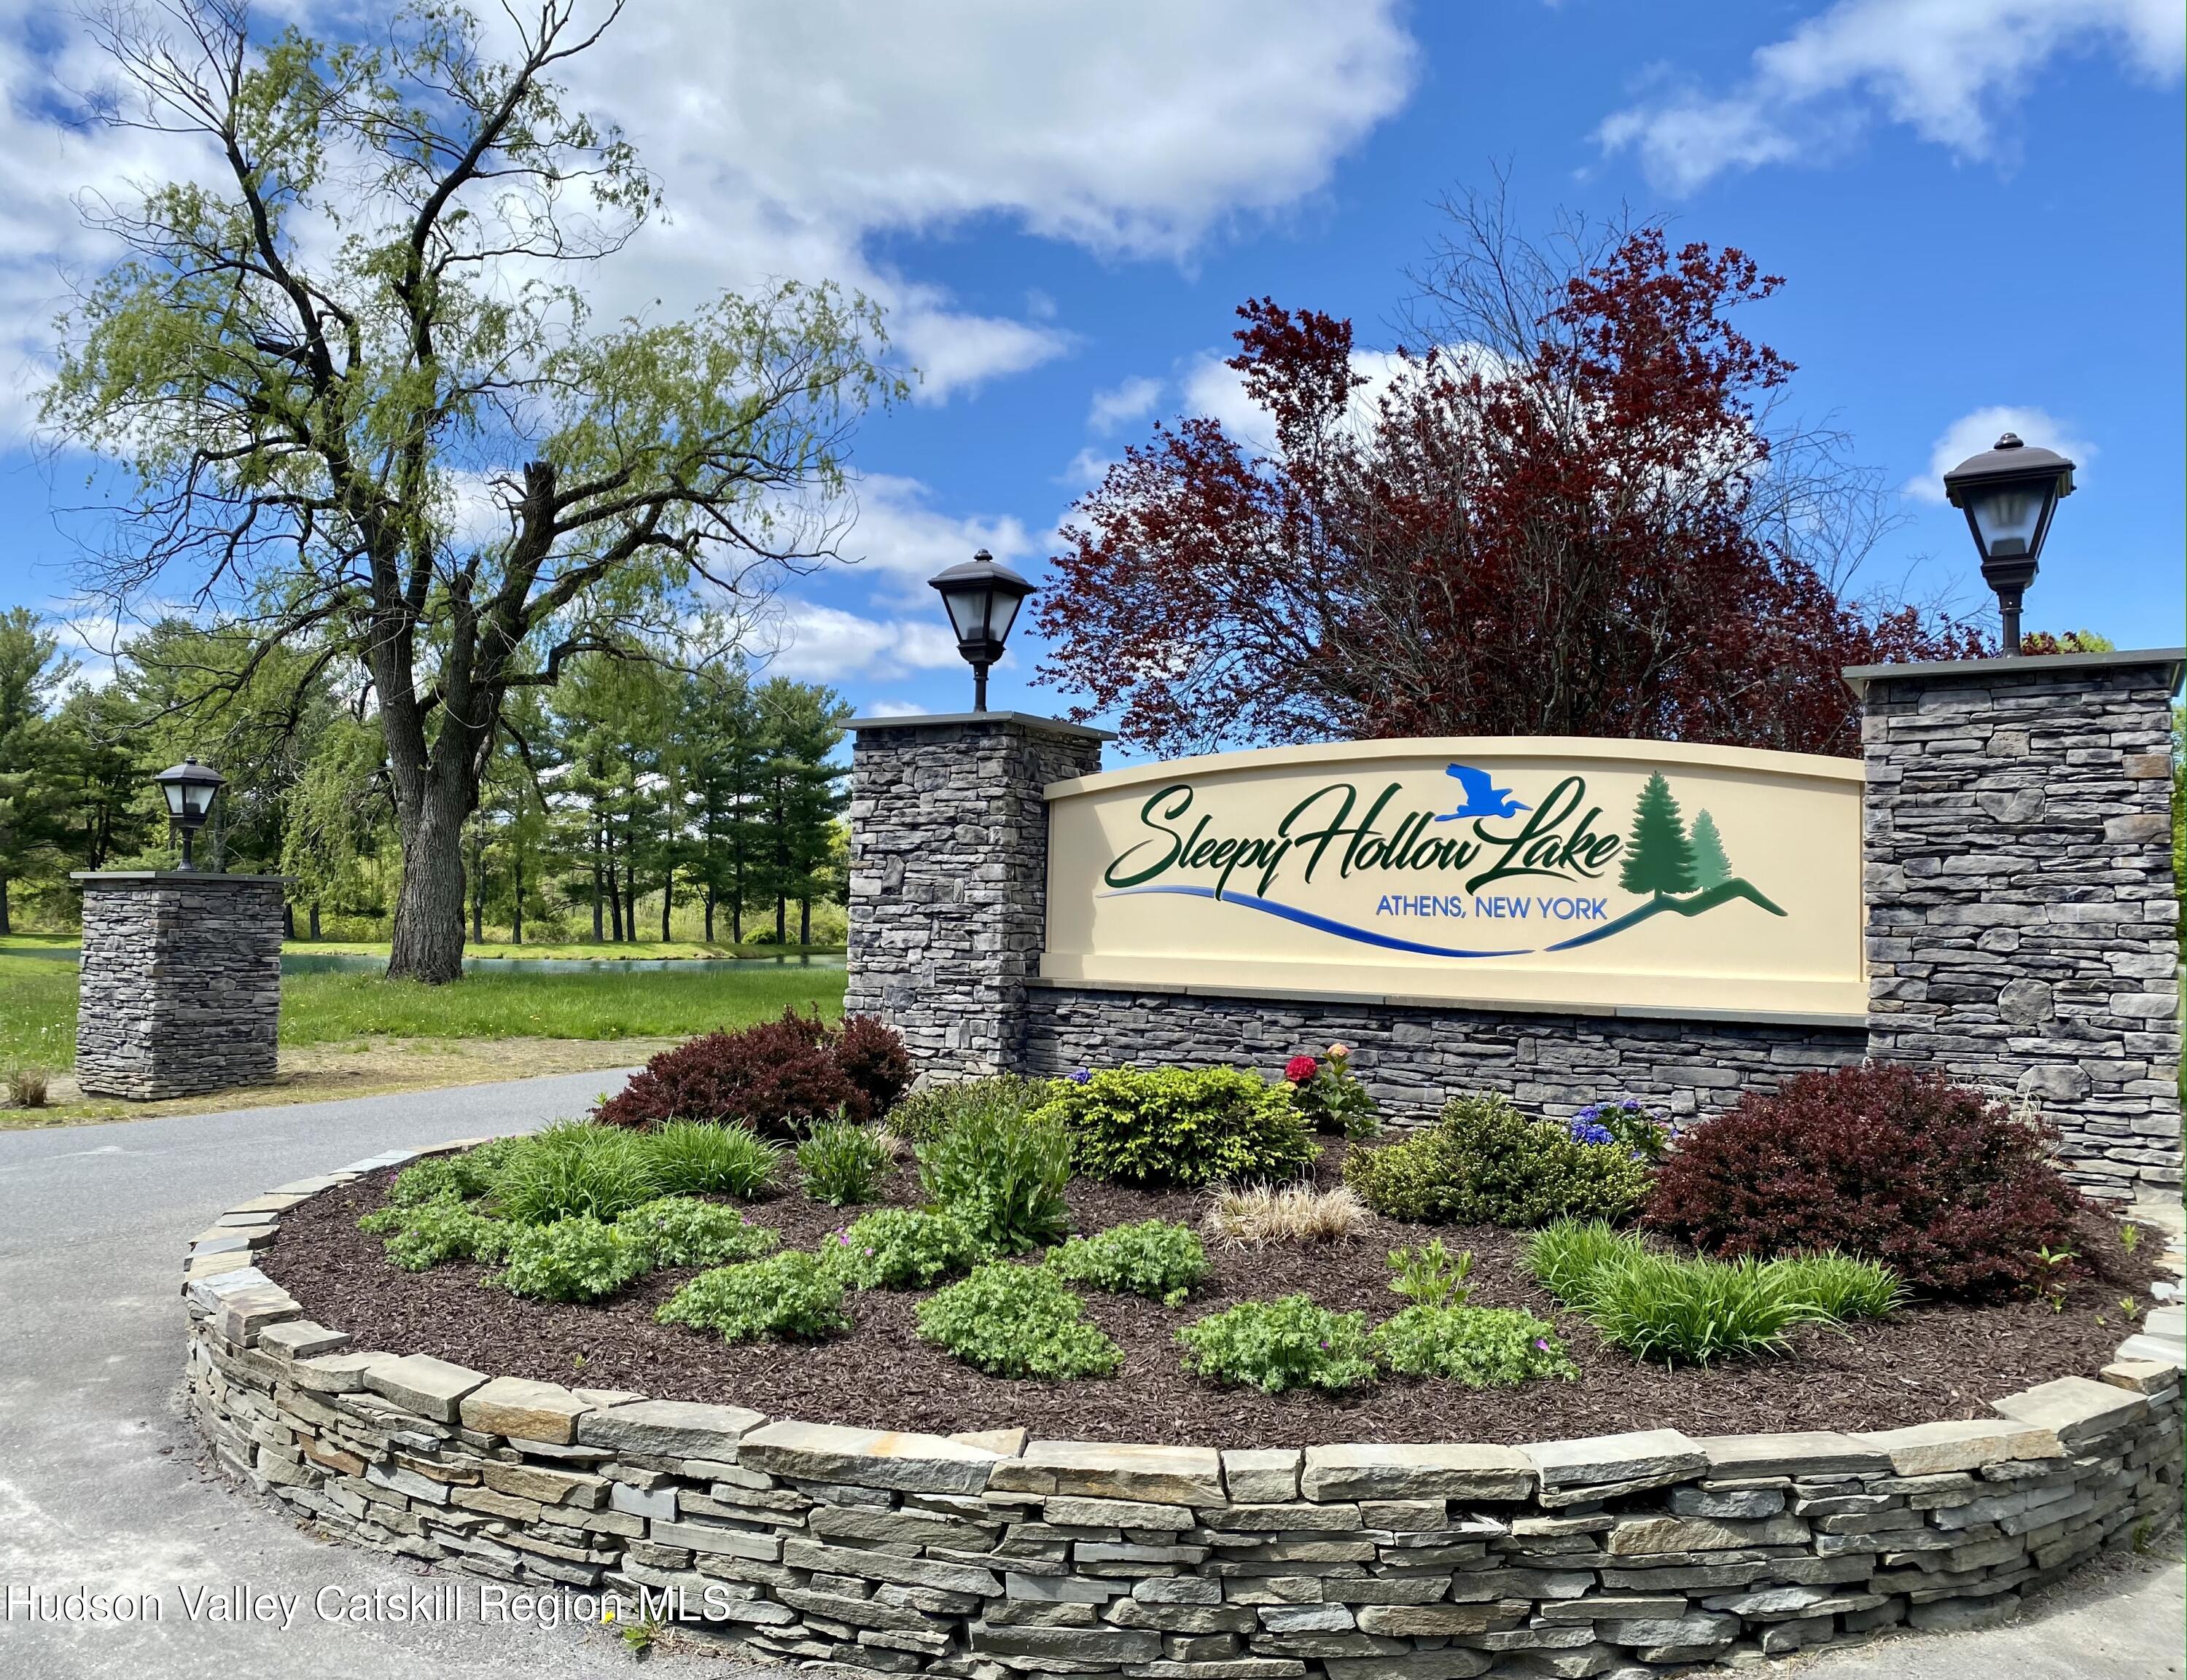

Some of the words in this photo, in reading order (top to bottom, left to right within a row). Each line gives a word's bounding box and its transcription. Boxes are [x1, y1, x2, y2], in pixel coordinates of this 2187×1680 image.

[1104, 784, 1292, 902] Sleepy
[1278, 782, 1482, 884] Hollow
[1465, 775, 1624, 896] Lake
[1376, 895, 1467, 918] ATHENS,
[1475, 896, 1530, 918] NEW
[1537, 897, 1607, 920] YORK
